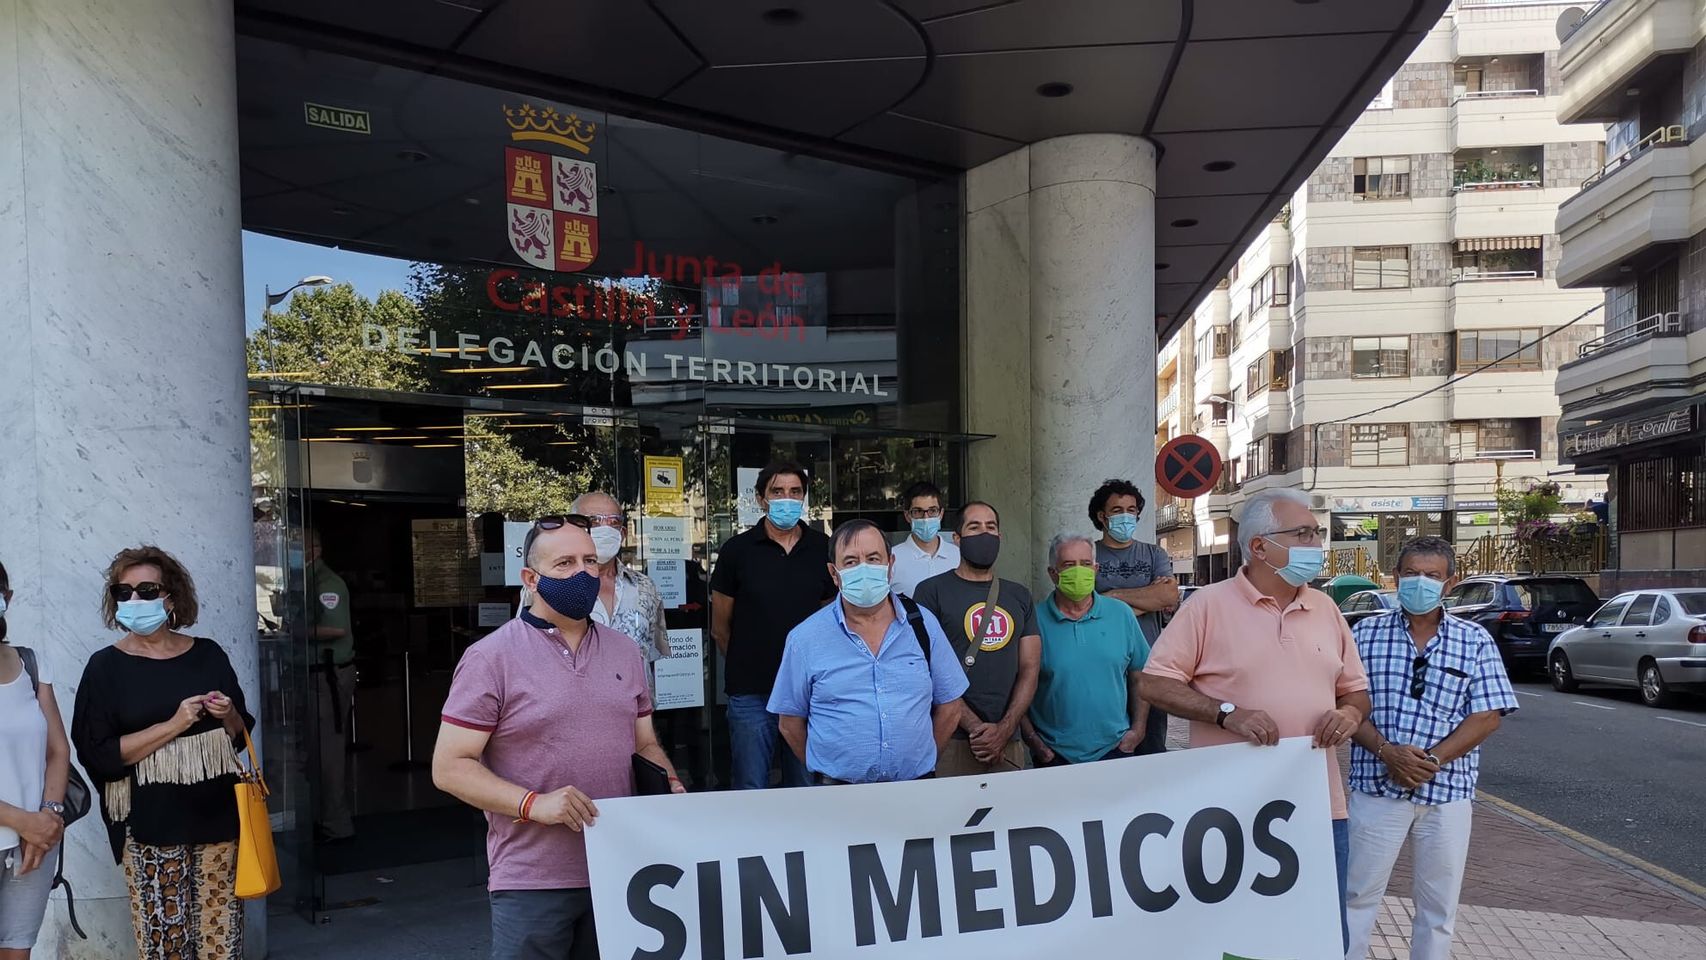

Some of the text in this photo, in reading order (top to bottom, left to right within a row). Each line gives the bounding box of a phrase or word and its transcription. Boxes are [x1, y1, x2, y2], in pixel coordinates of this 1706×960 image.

[309, 107, 366, 130] SALIDA
[624, 241, 804, 299] Junta de
[488, 267, 806, 342] Castilla y León
[361, 322, 889, 396] DELEGACIÓN TERRITORIAL
[1371, 498, 1402, 508] asiste
[667, 636, 684, 644] fono
[668, 643, 697, 651] rmación
[626, 799, 1300, 960] SIN MÉDICOS
